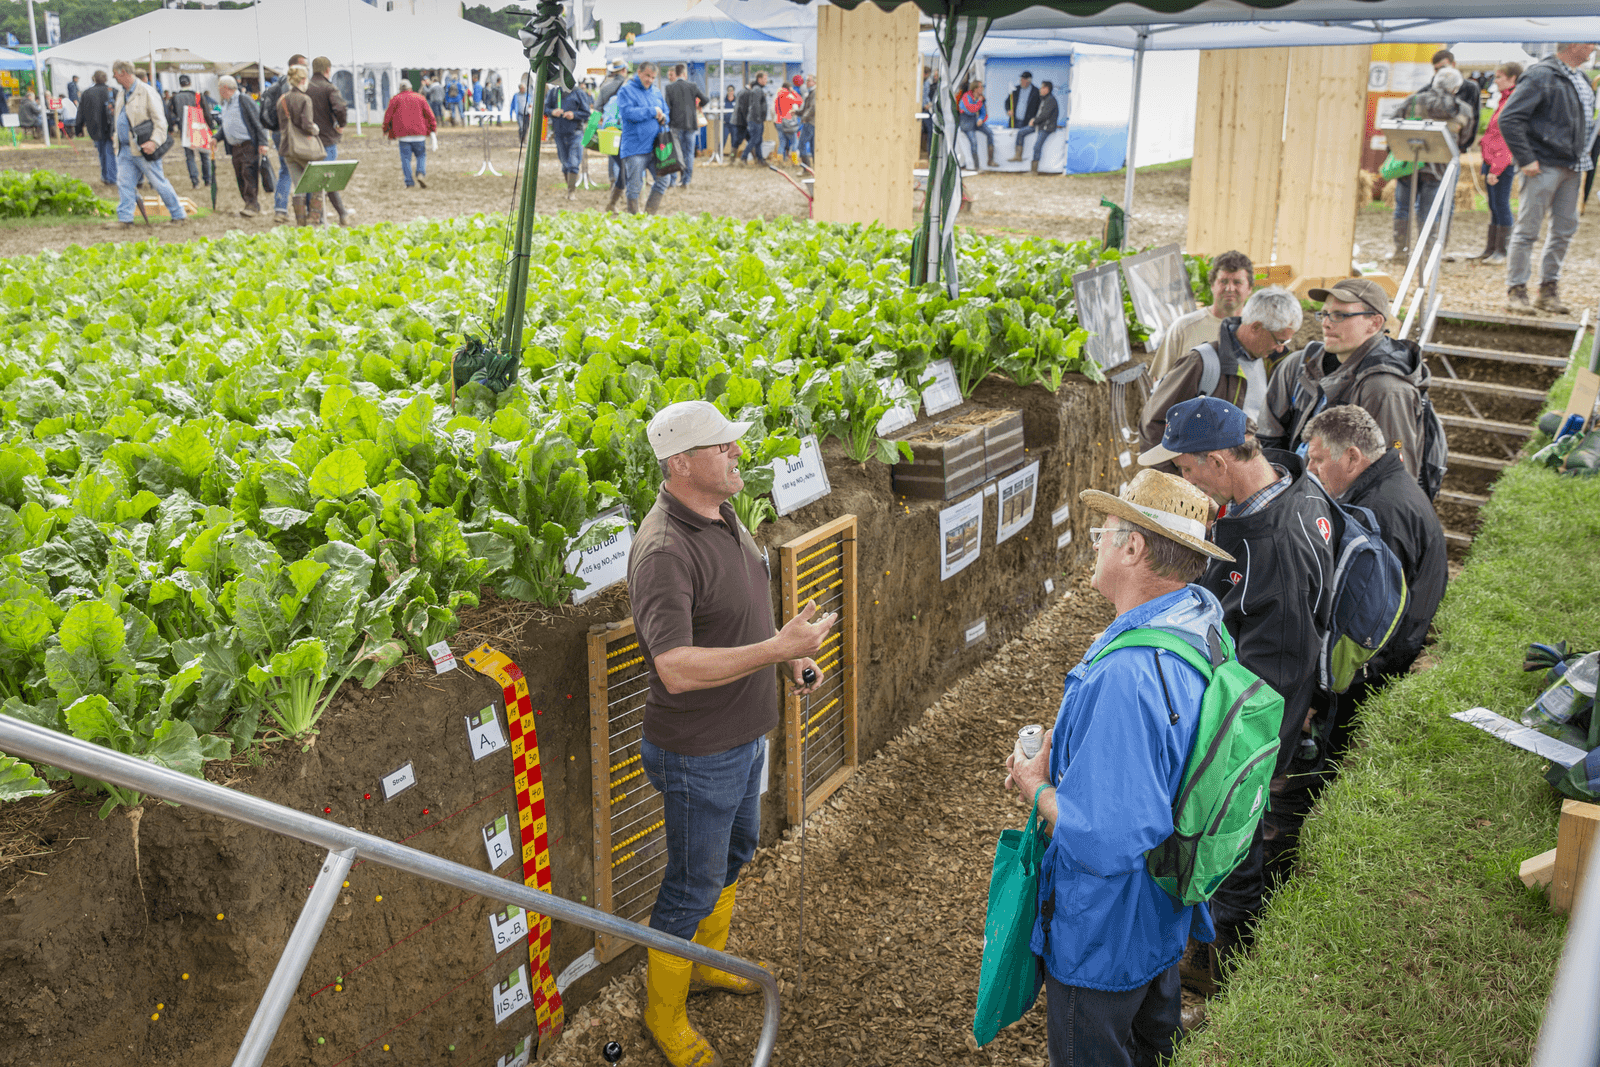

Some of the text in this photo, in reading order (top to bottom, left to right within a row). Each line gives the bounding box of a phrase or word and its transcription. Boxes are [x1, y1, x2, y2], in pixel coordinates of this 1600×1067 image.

[787, 458, 804, 473] Juni
[582, 564, 593, 575] 105
[594, 561, 601, 570] kg
[509, 706, 517, 719] 15
[524, 719, 531, 728] 20
[514, 742, 523, 754] 25
[528, 753, 538, 765] 30
[392, 775, 406, 786] Stroh
[517, 776, 526, 790] 35
[532, 787, 542, 798] 40
[522, 812, 530, 822] 45
[536, 822, 544, 834] 50
[525, 845, 534, 858] 55
[539, 854, 548, 866] 60
[530, 913, 538, 922] 75
